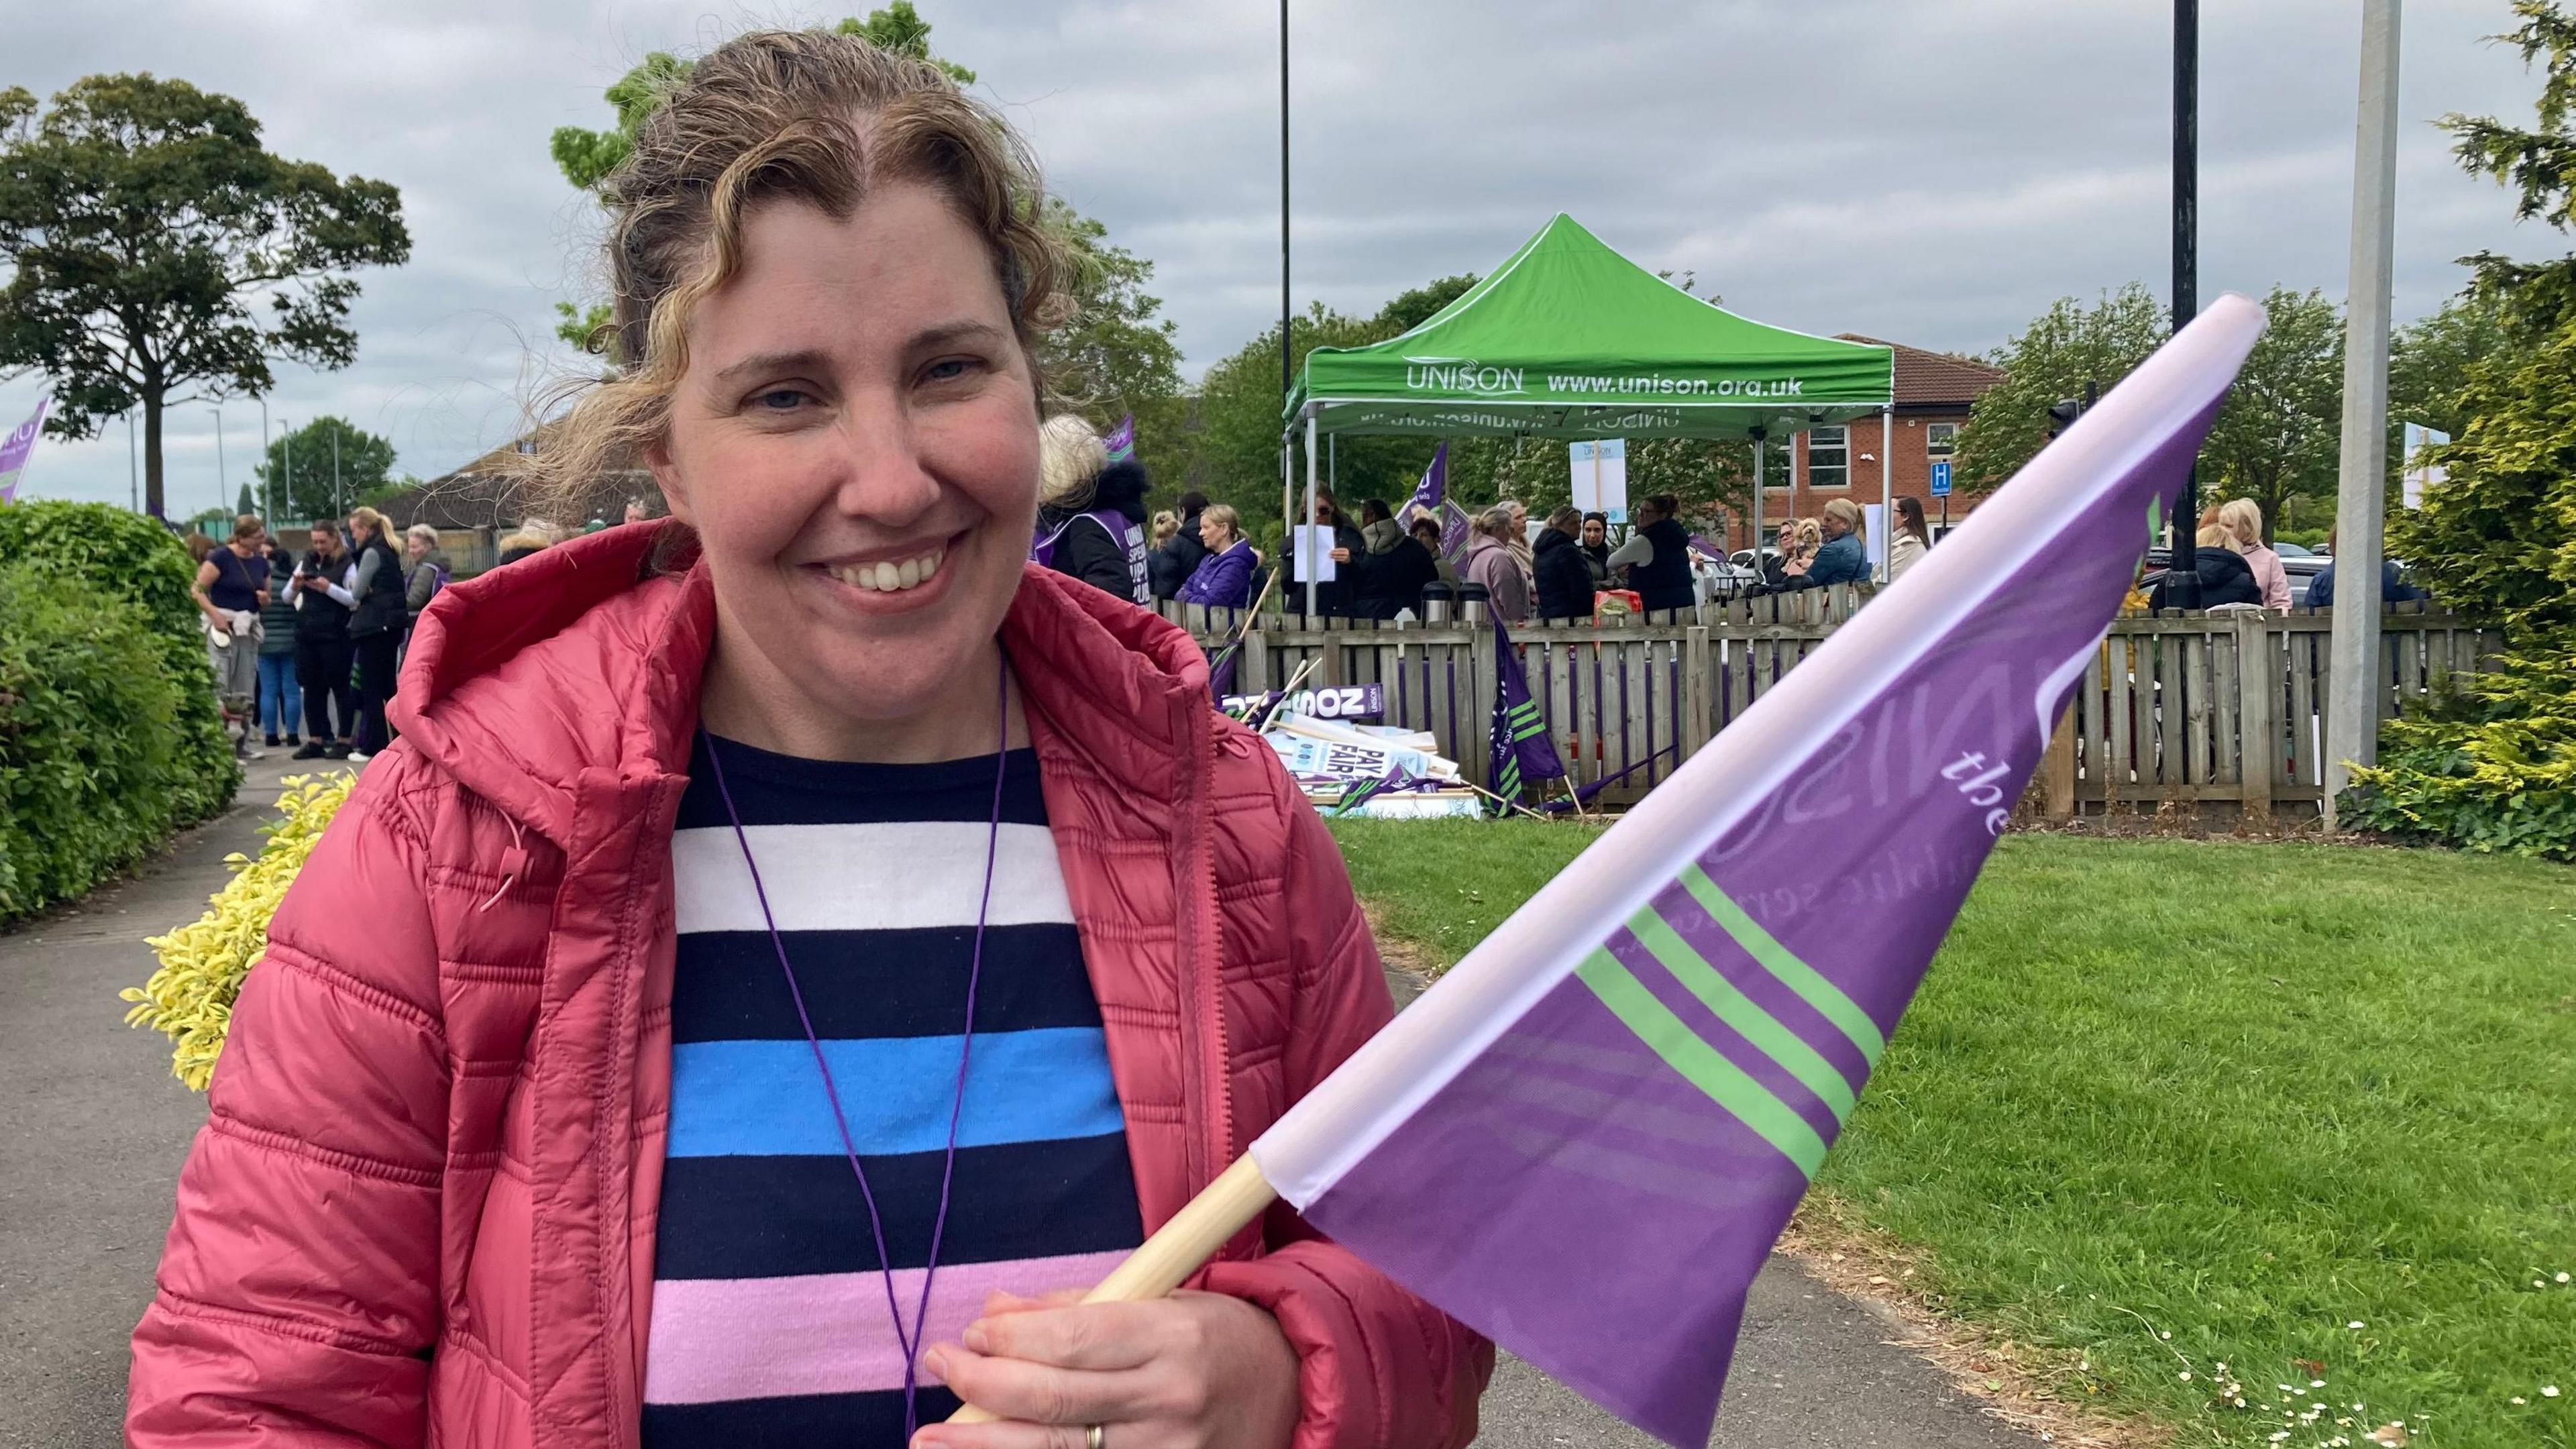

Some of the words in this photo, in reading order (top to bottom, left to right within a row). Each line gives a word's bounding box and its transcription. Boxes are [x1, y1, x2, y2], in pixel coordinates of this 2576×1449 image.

[1405, 363, 1525, 392] UNISON
[1547, 373, 1803, 397] www.unison.org.uk
[1584, 447, 1612, 457] UNON
[1935, 464, 1947, 486] H
[1326, 743, 1358, 774] FAIR
[1355, 749, 1385, 774] PAY
[1940, 750, 2012, 837] the
